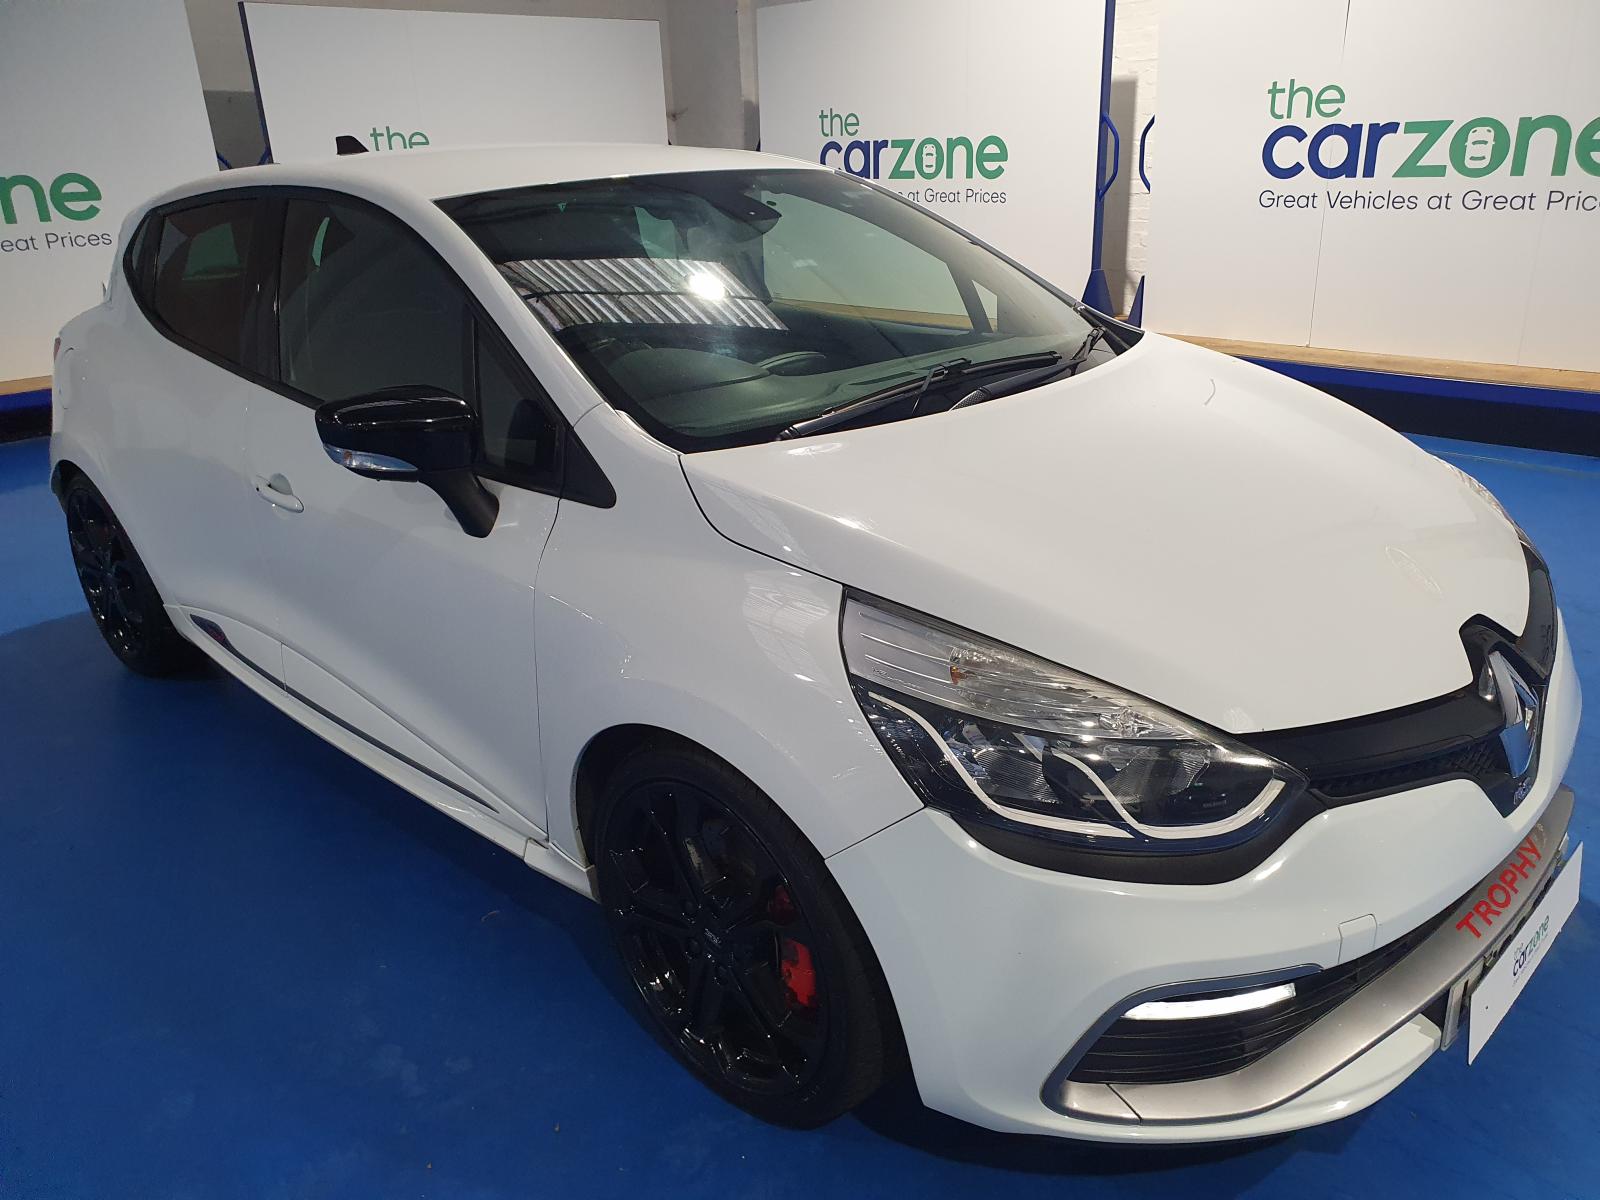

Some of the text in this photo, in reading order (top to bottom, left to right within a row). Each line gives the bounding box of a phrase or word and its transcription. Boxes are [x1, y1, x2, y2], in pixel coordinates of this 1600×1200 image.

[1268, 78, 1346, 119] the
[819, 108, 860, 137] the
[819, 135, 1009, 180] carzone
[924, 188, 961, 203] Great
[965, 188, 1007, 203] Prices
[1259, 190, 1600, 211] Great Vehicles at Great Pric
[0, 231, 113, 252] eat Prices
[1456, 835, 1542, 939] TROPHY
